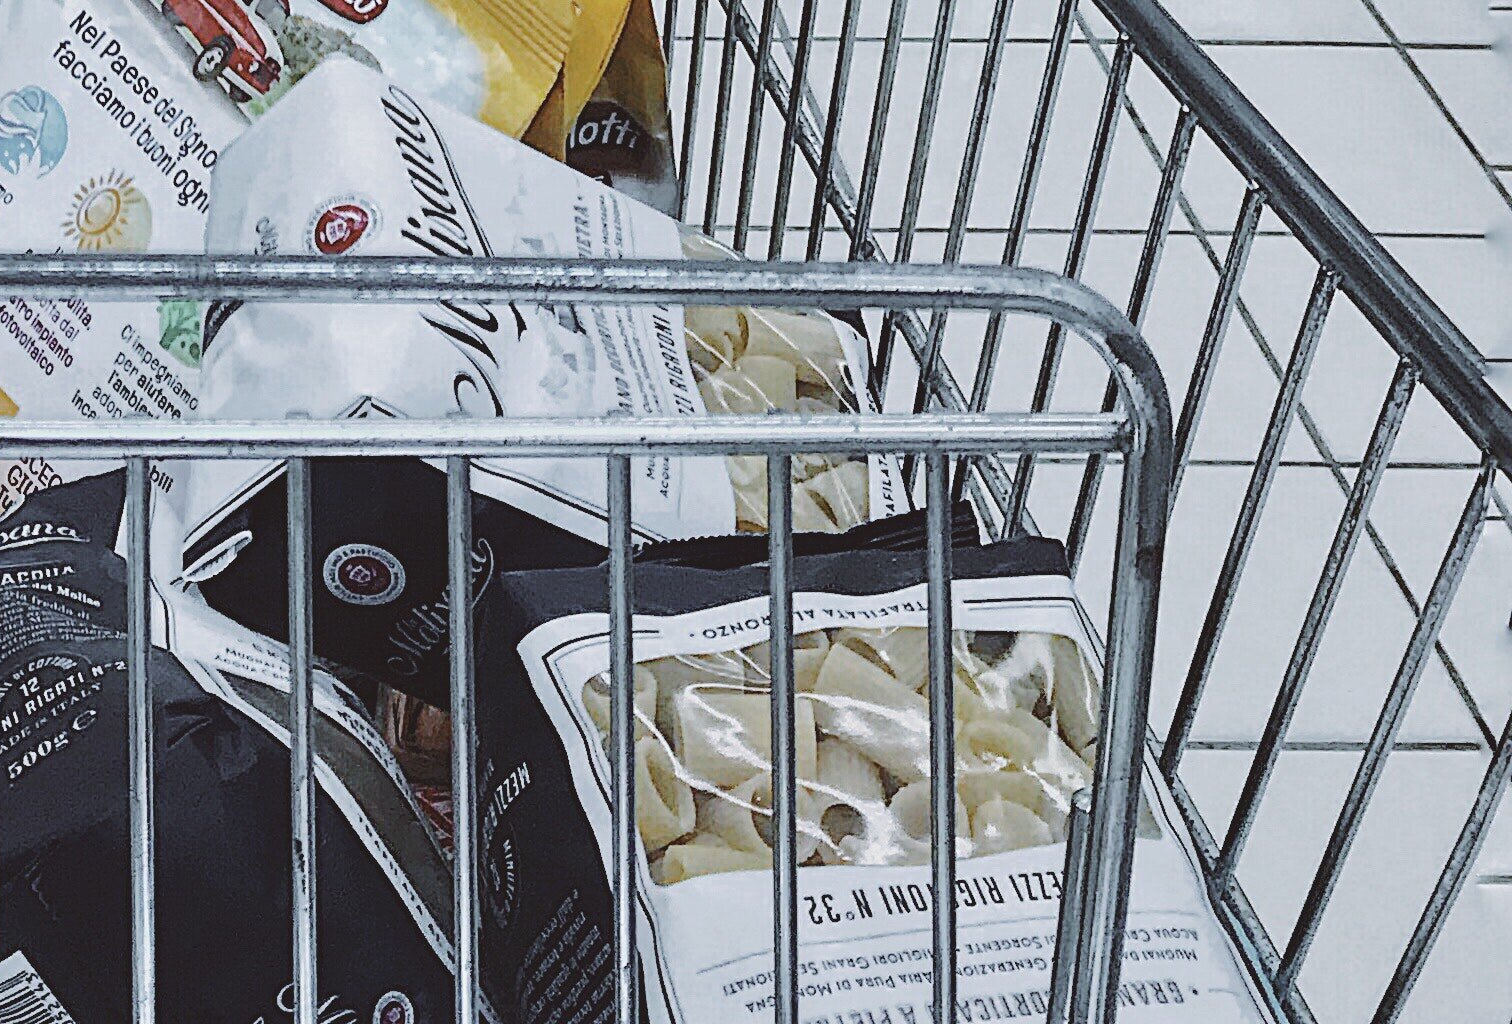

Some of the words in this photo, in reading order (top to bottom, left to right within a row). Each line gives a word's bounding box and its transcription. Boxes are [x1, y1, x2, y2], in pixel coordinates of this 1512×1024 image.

[53, 40, 136, 128] facciamo
[69, 10, 107, 50] Nel
[99, 39, 159, 105] Paese
[154, 97, 183, 129] del
[173, 116, 218, 169] Signo
[130, 117, 146, 137] i
[137, 124, 182, 176] buoni
[31, 314, 74, 368] impianto
[59, 319, 80, 342] dal
[652, 313, 688, 393] RIGATONI
[114, 351, 138, 376] per
[137, 374, 182, 419] aiutare
[131, 335, 199, 411] impegniamo
[793, 610, 814, 621] AL
[823, 600, 929, 619] TRAFILATA
[702, 614, 771, 639] RONZO
[19, 676, 41, 697] 12
[24, 671, 85, 716] RIGATI
[50, 682, 102, 717] ITALY
[8, 730, 70, 780] 500g
[494, 761, 531, 815] MEZZI
[878, 876, 1006, 916] RIGONI
[1011, 871, 1065, 903] EZZI
[968, 936, 1044, 954] SORGENTE
[1157, 927, 1199, 941] ACQUA
[820, 954, 869, 970] GRANI
[956, 956, 1048, 976] GENERAZION
[1143, 948, 1198, 962] MUGNAI
[722, 962, 818, 997] SEIONATI
[837, 980, 851, 991] DI
[856, 975, 896, 989] PURA
[900, 970, 932, 985] ARIA
[745, 981, 833, 1013] MONGNA
[1120, 979, 1185, 1007] GRAN
